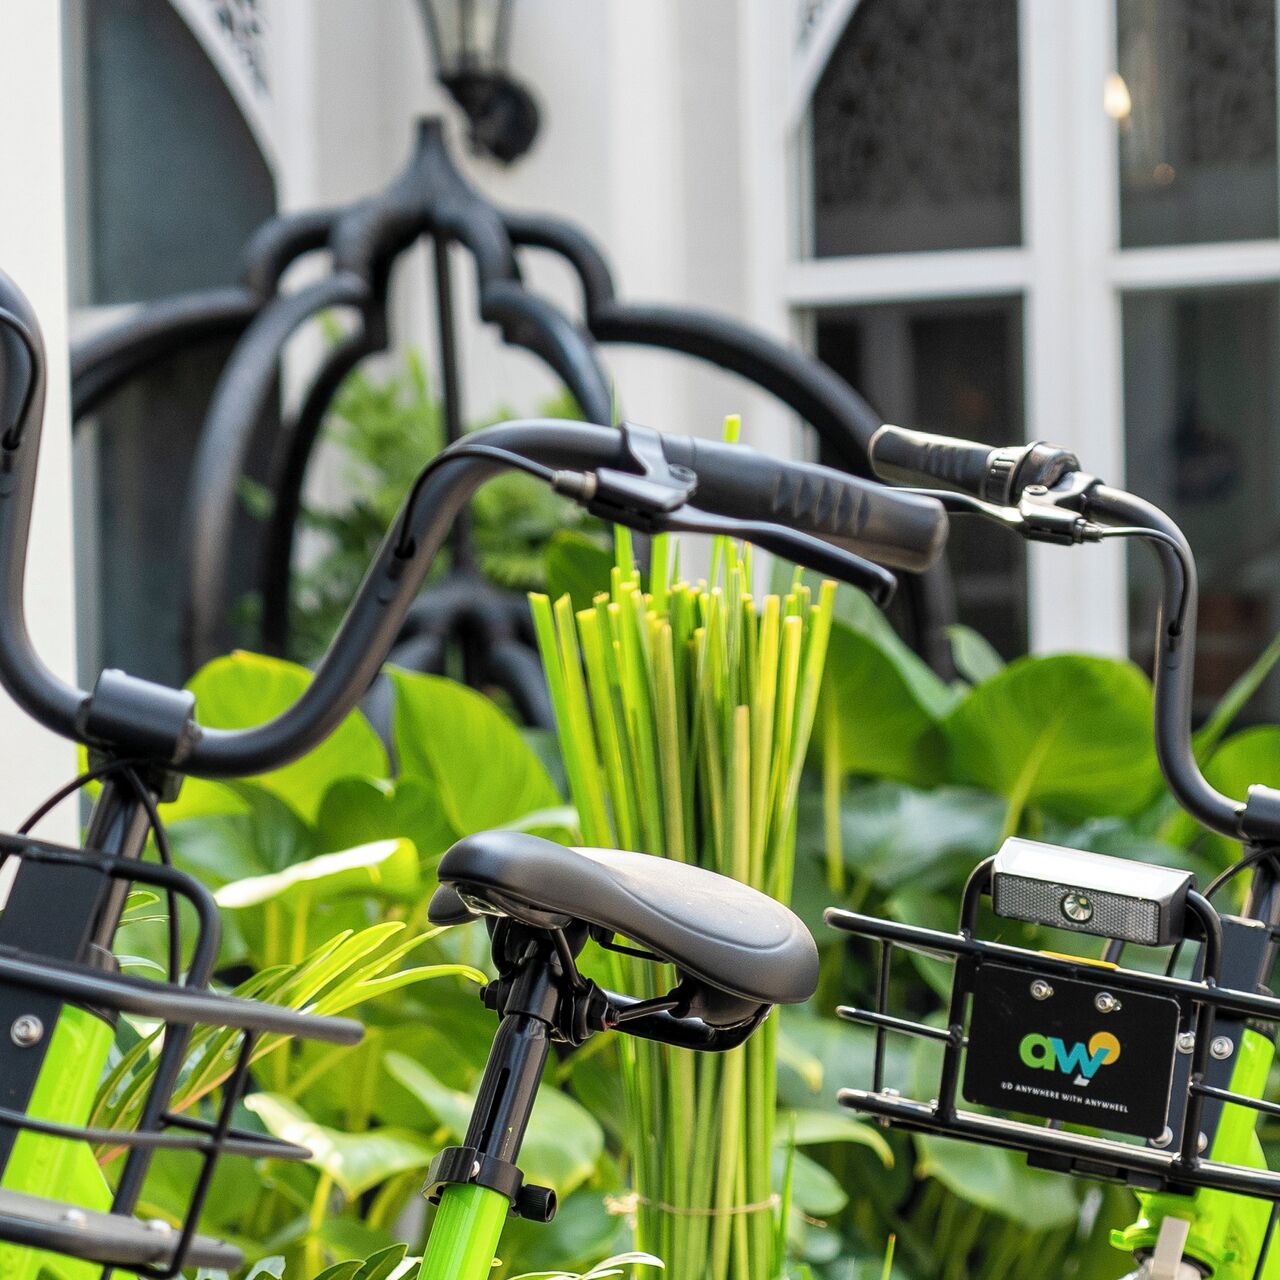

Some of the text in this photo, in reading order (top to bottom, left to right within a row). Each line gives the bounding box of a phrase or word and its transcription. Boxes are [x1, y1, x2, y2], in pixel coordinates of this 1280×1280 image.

[1015, 1084, 1060, 1100] ANYWHERE
[1061, 1093, 1083, 1104] WITH
[1084, 1098, 1129, 1113] ANYWHEEL
